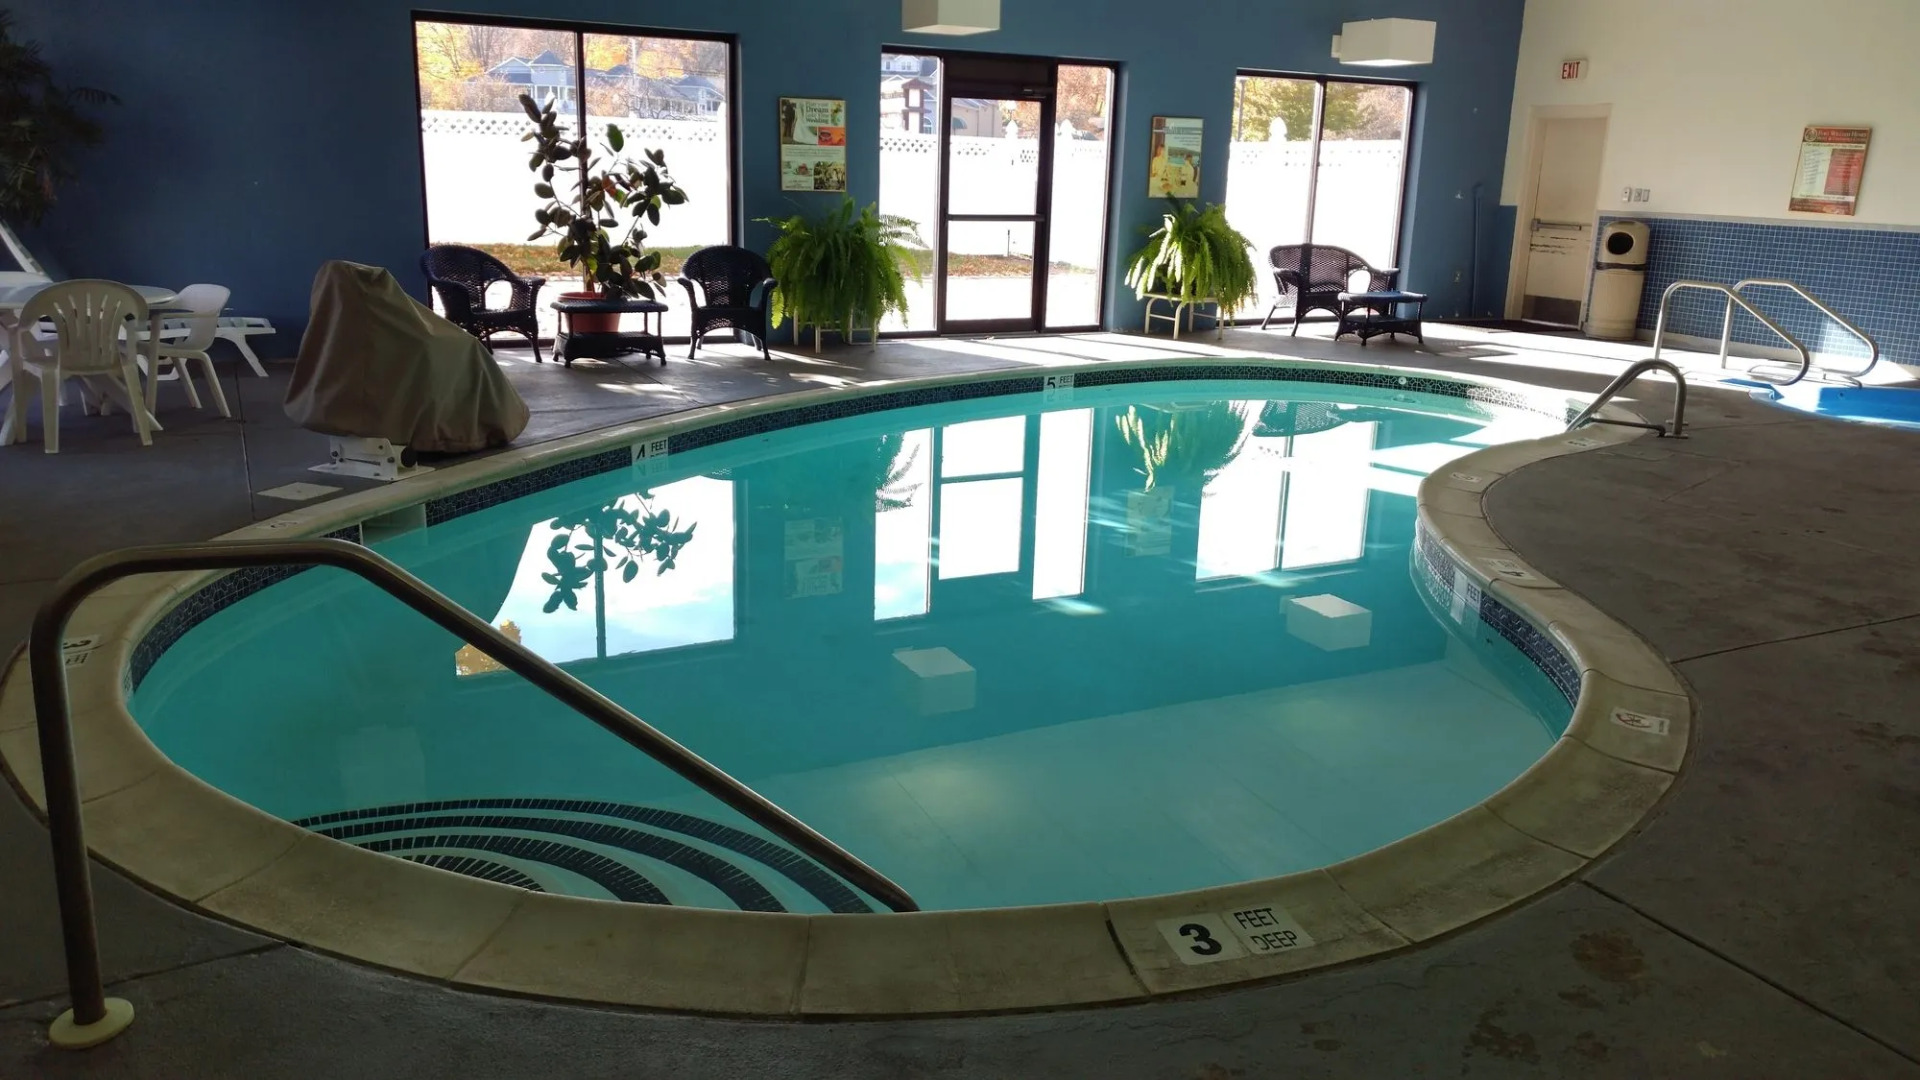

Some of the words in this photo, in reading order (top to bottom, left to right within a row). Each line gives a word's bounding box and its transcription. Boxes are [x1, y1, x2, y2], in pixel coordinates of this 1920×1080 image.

[1562, 61, 1580, 79] EXIT
[651, 440, 667, 452] FEET
[1233, 907, 1279, 930] FEET
[1179, 923, 1222, 955] 3
[1250, 930, 1298, 951] DEEP
